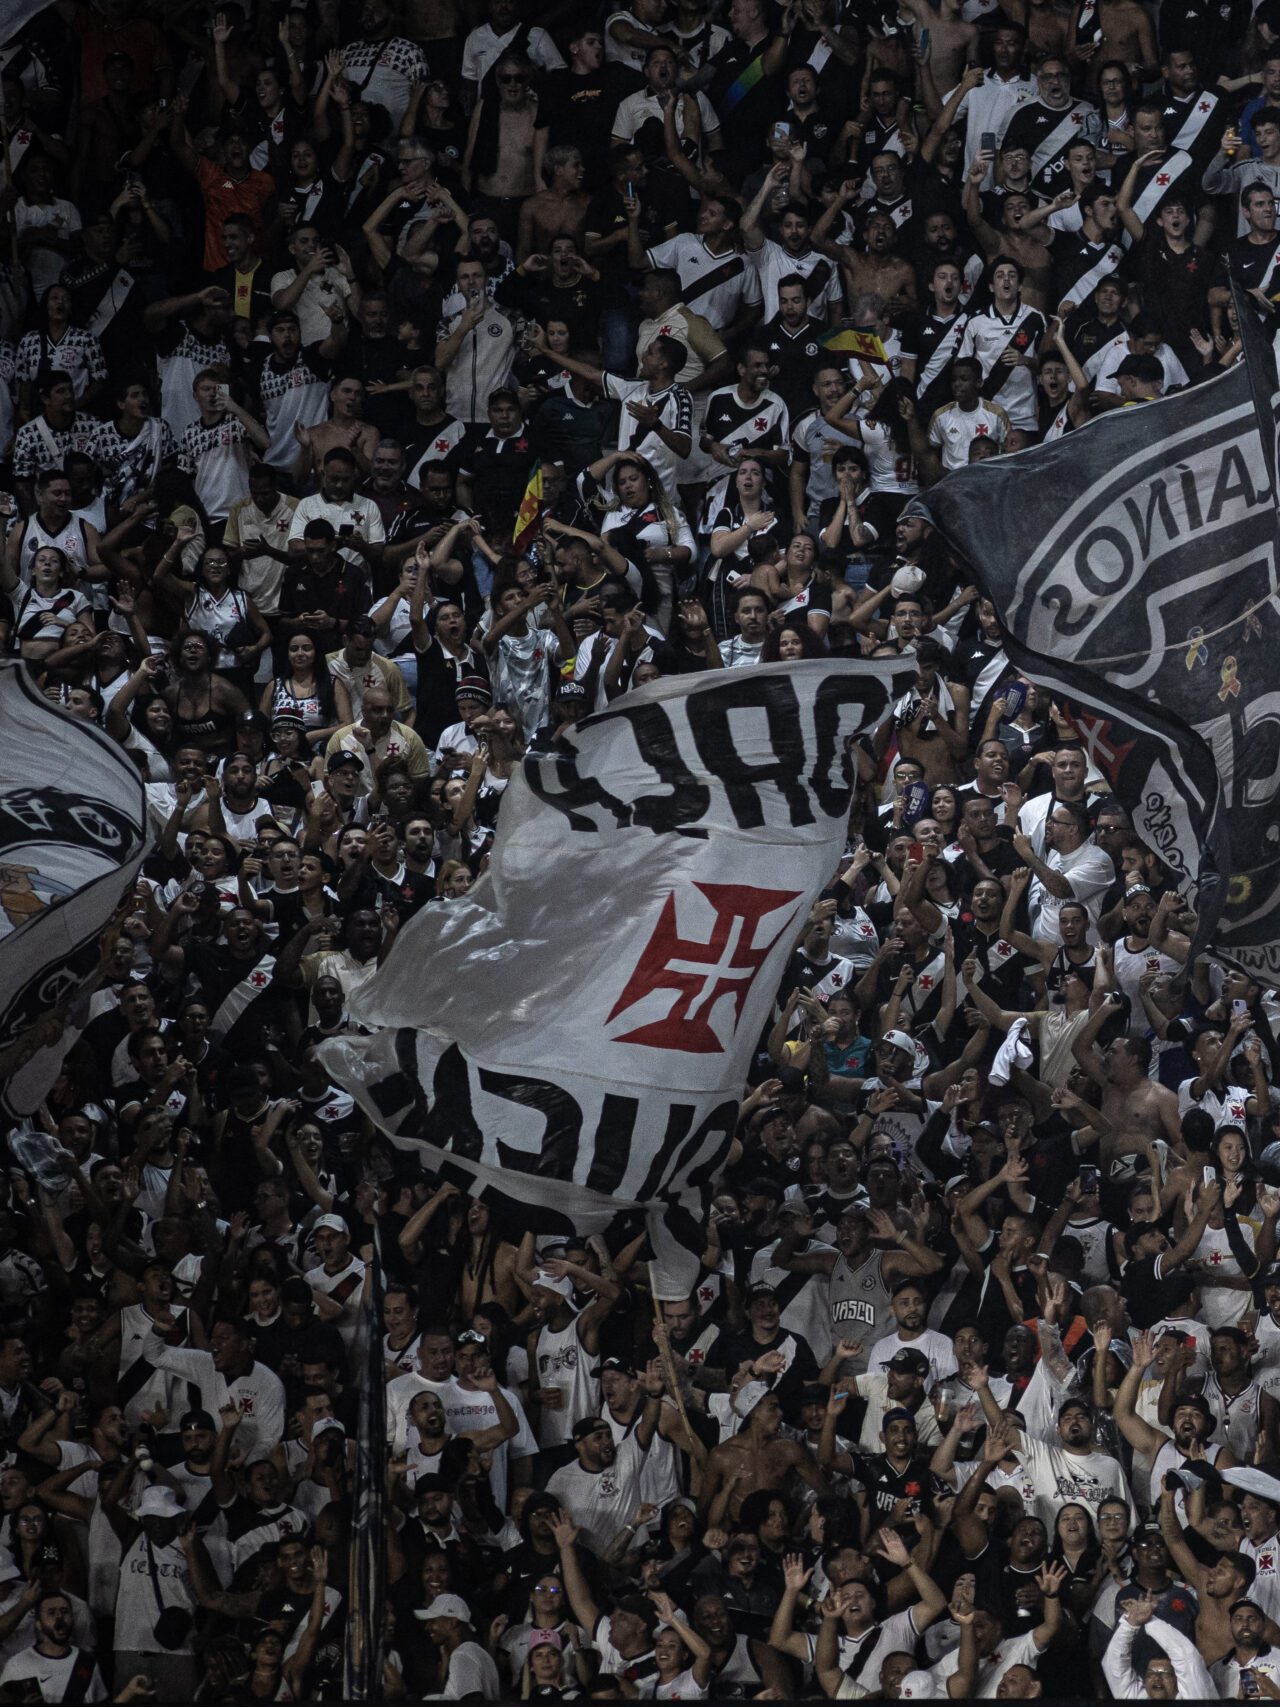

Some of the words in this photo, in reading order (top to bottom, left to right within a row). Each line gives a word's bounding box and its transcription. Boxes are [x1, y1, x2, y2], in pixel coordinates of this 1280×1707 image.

[831, 1298, 876, 1327] VASCO
[446, 1404, 472, 1417] ORÇA
[481, 1403, 496, 1416] JO
